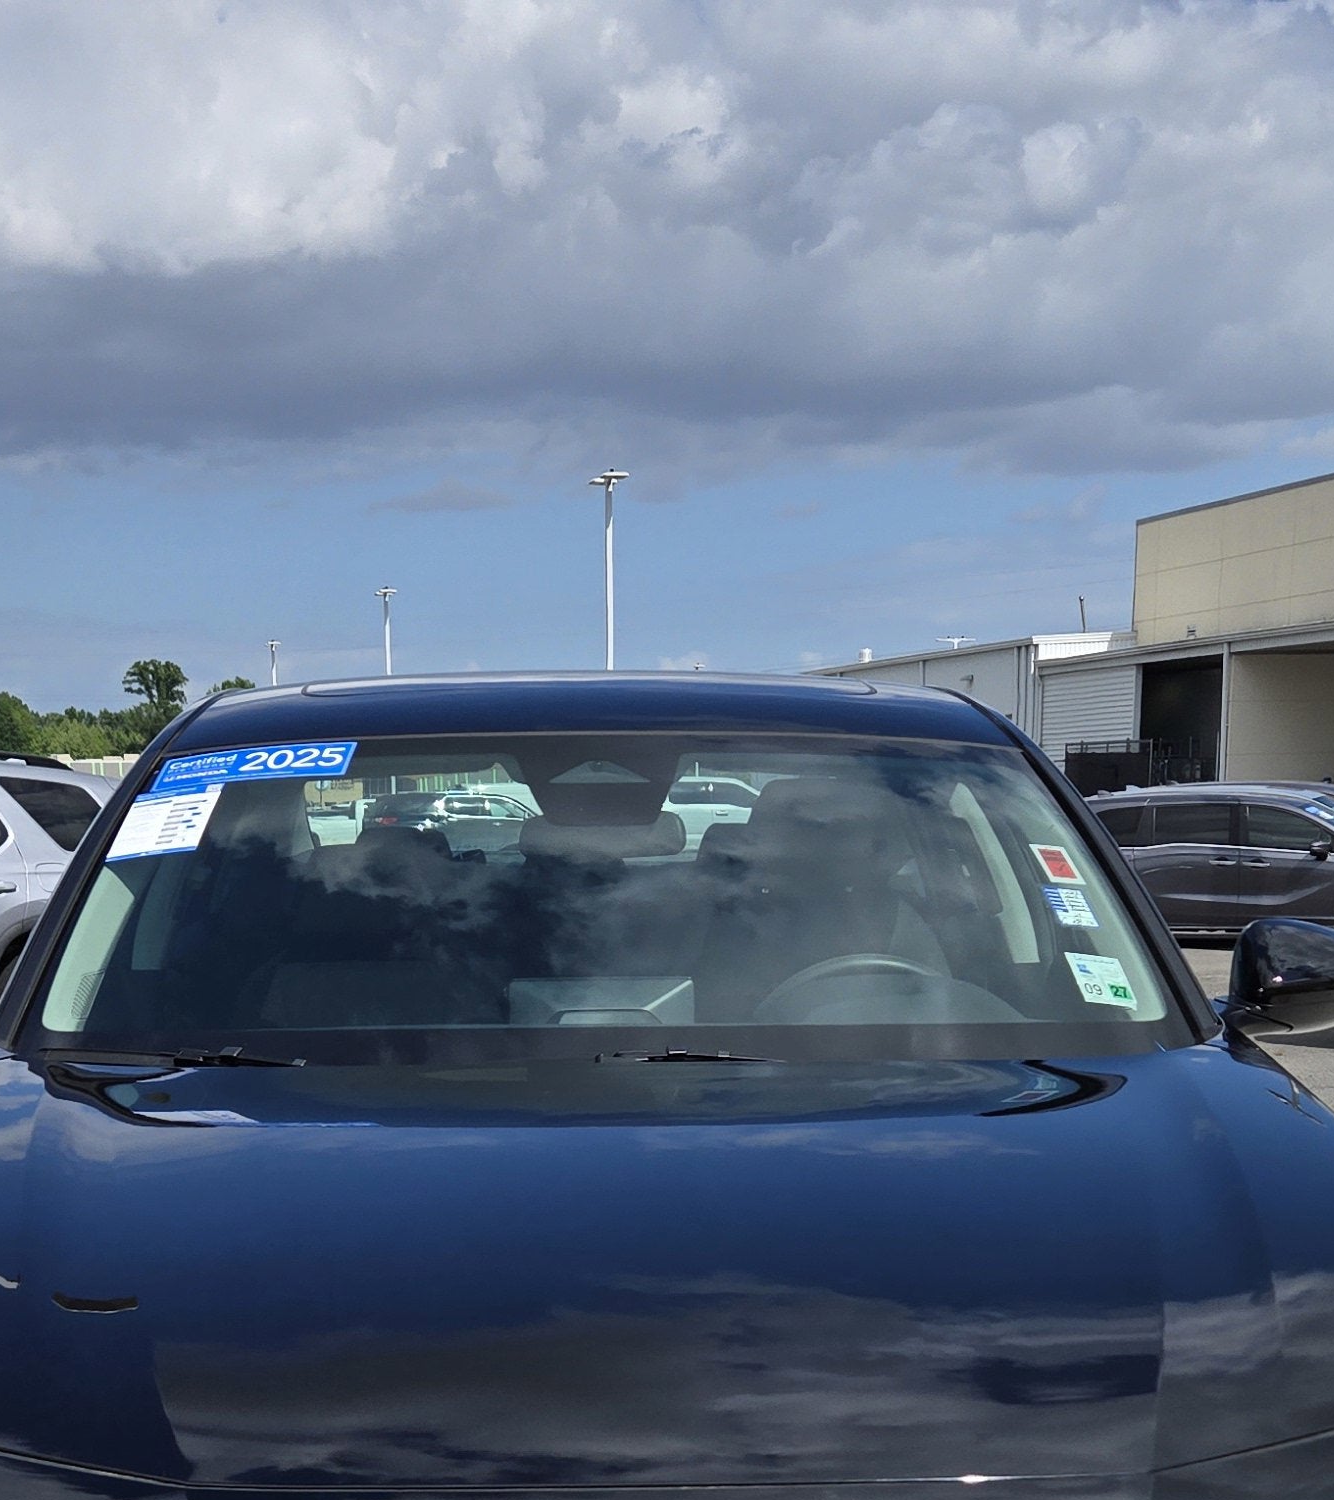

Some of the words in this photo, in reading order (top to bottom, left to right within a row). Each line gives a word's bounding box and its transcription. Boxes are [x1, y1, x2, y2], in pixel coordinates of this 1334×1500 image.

[169, 753, 238, 770] Certified
[238, 747, 347, 772] 2025
[1084, 982, 1103, 996] 09
[1109, 984, 1128, 999] 27
